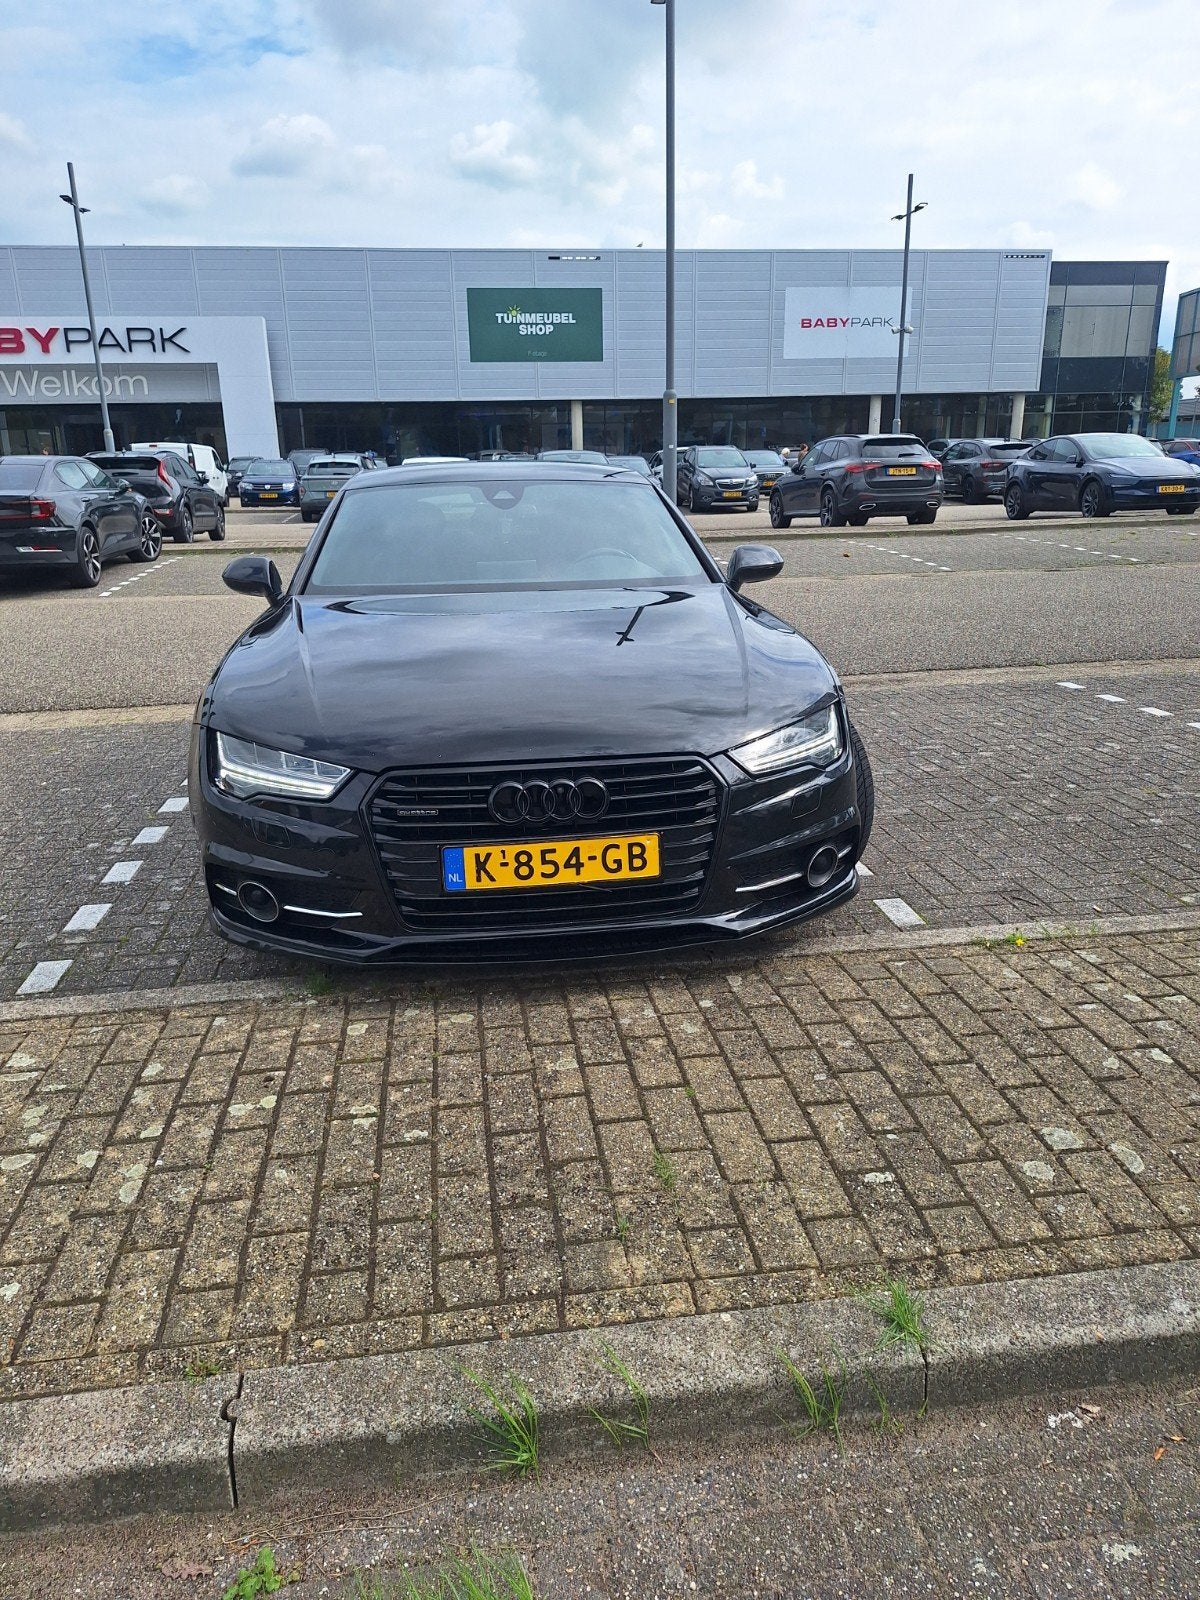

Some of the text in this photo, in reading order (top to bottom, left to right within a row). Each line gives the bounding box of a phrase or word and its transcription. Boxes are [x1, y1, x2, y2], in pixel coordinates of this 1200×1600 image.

[800, 317, 894, 329] BABYPARK
[518, 324, 554, 335] SHOP
[0, 369, 149, 397] Welkom
[448, 873, 463, 883] NL
